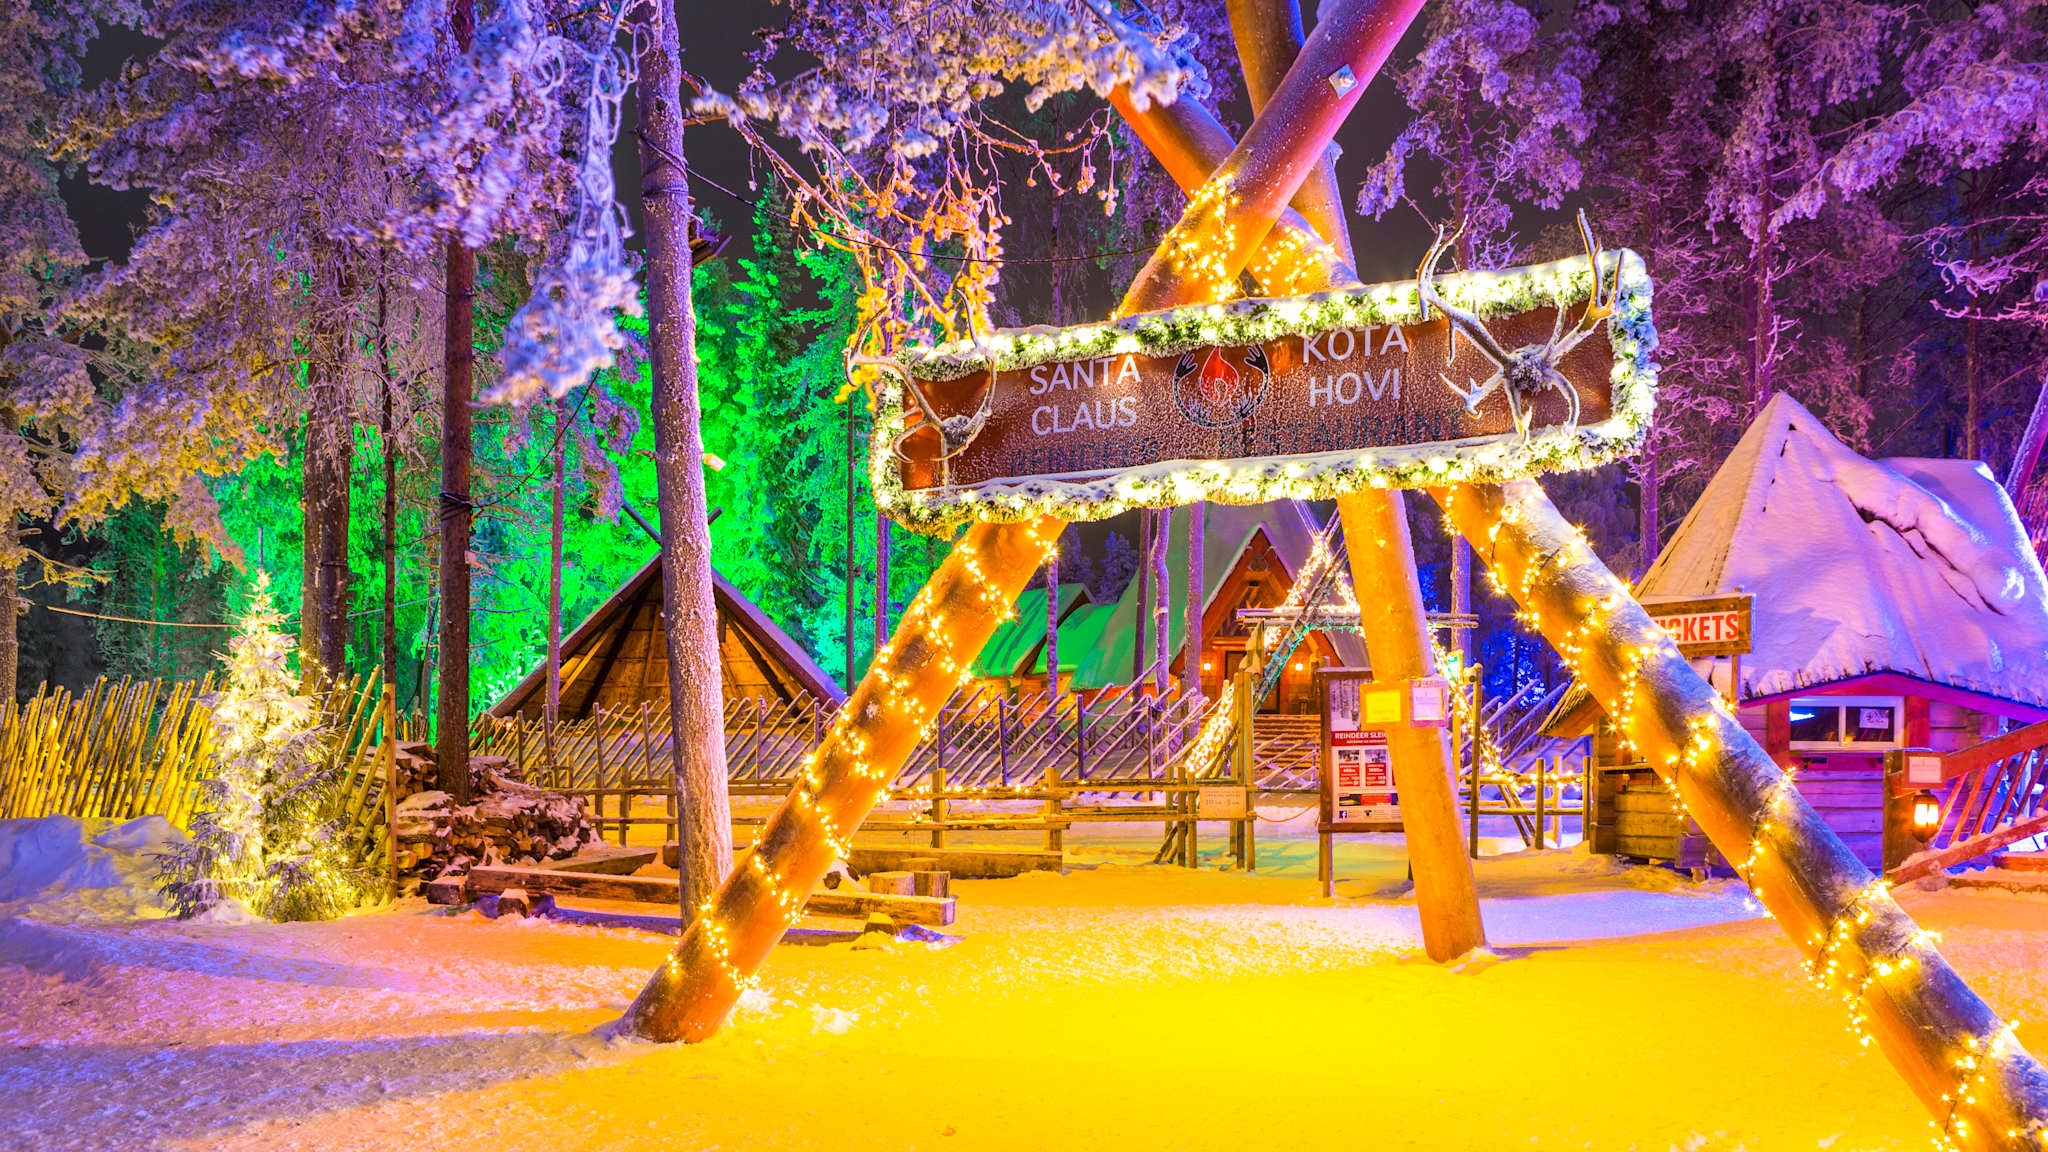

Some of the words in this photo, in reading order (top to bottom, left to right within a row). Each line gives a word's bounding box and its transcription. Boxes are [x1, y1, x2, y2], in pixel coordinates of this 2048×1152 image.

[1302, 324, 1410, 363] KOTA
[1029, 354, 1141, 395] SANTA
[1309, 367, 1400, 408] HOVI
[1031, 396, 1137, 436] CLAUS
[1218, 408, 1466, 458] RESTAURANT
[1654, 613, 1739, 642] CKETS
